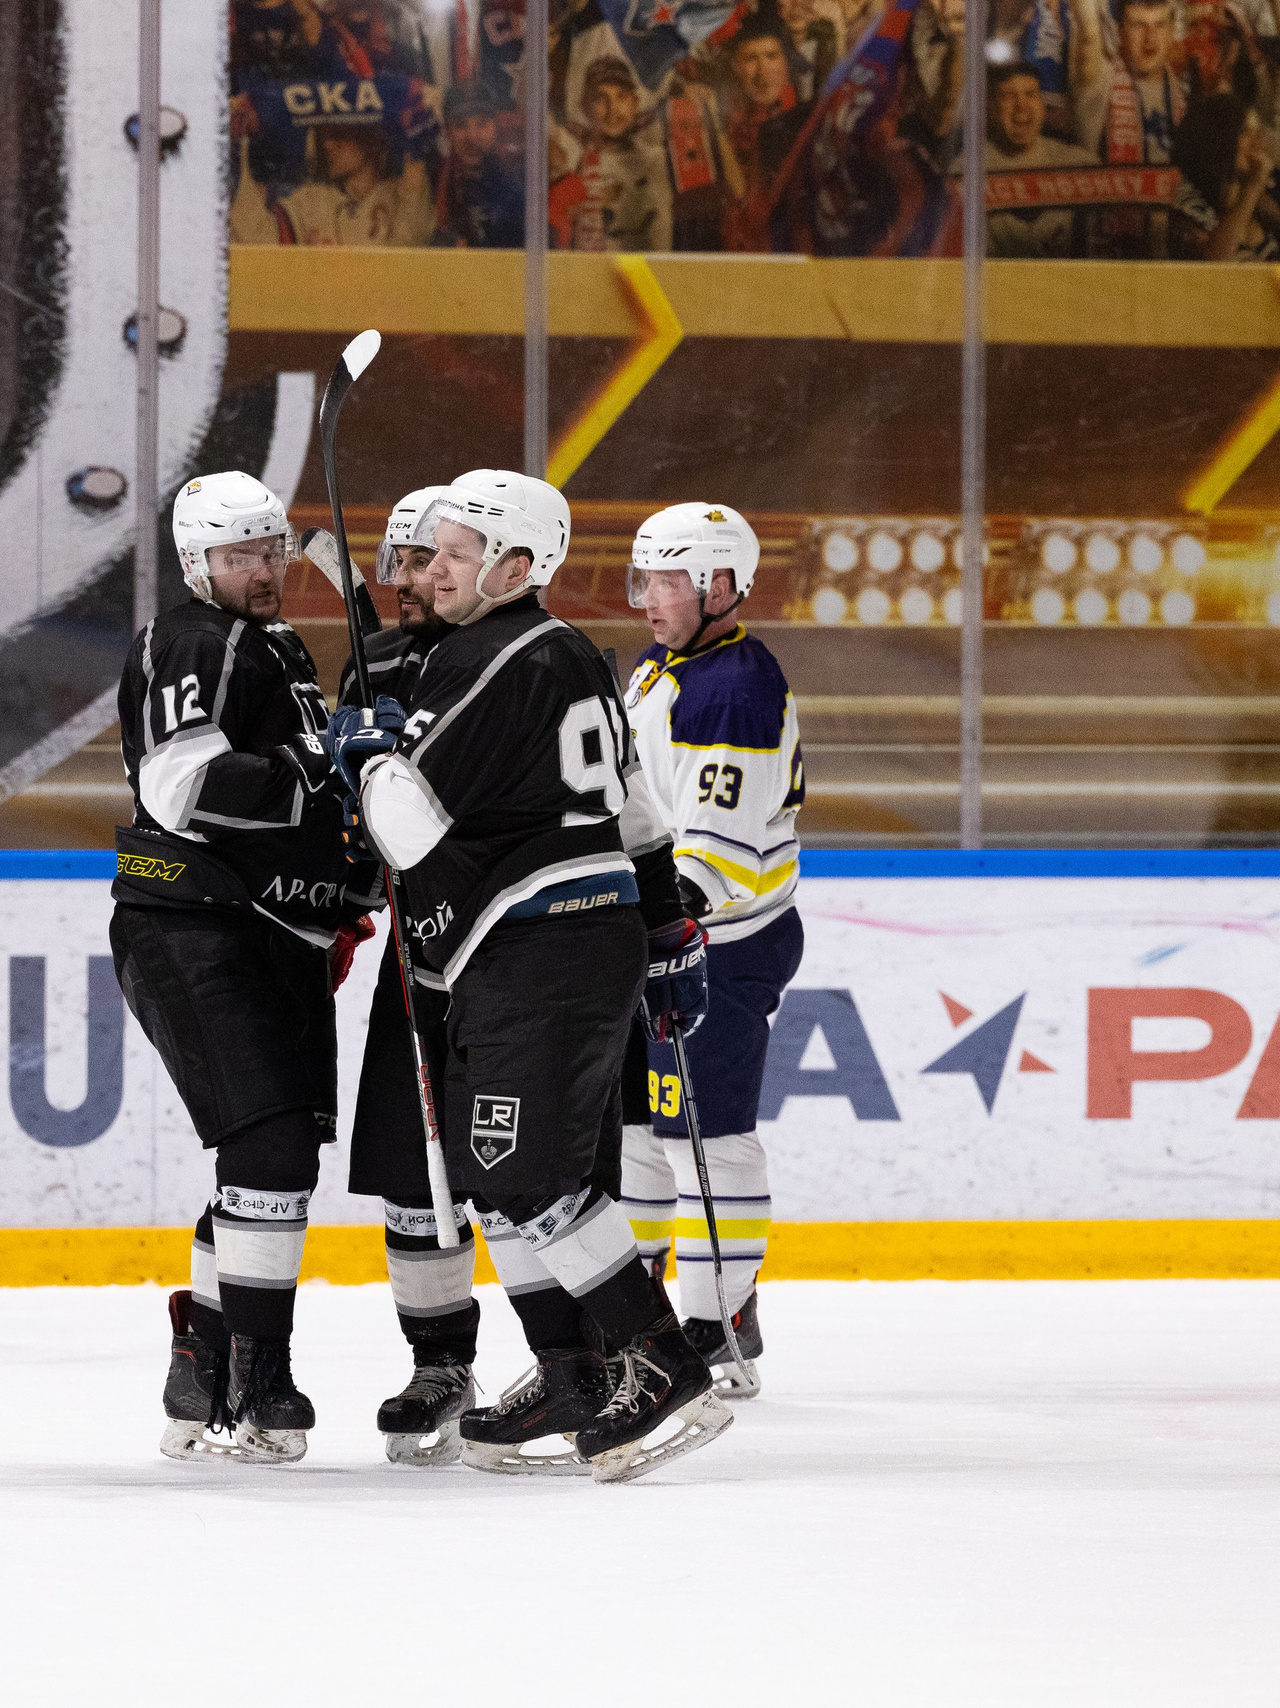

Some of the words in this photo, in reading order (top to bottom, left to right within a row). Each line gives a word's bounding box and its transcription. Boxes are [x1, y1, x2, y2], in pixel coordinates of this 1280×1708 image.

[283, 80, 384, 116] СКА
[389, 522, 412, 530] CCM
[161, 664, 207, 733] 12
[400, 709, 437, 748] 5
[558, 694, 625, 828] 9
[698, 763, 743, 810] 93
[548, 892, 619, 914] BAUER
[647, 945, 706, 978] AUER
[647, 1069, 681, 1118] 93
[475, 1103, 513, 1128] LR
[699, 1165, 710, 1197] BAUER
